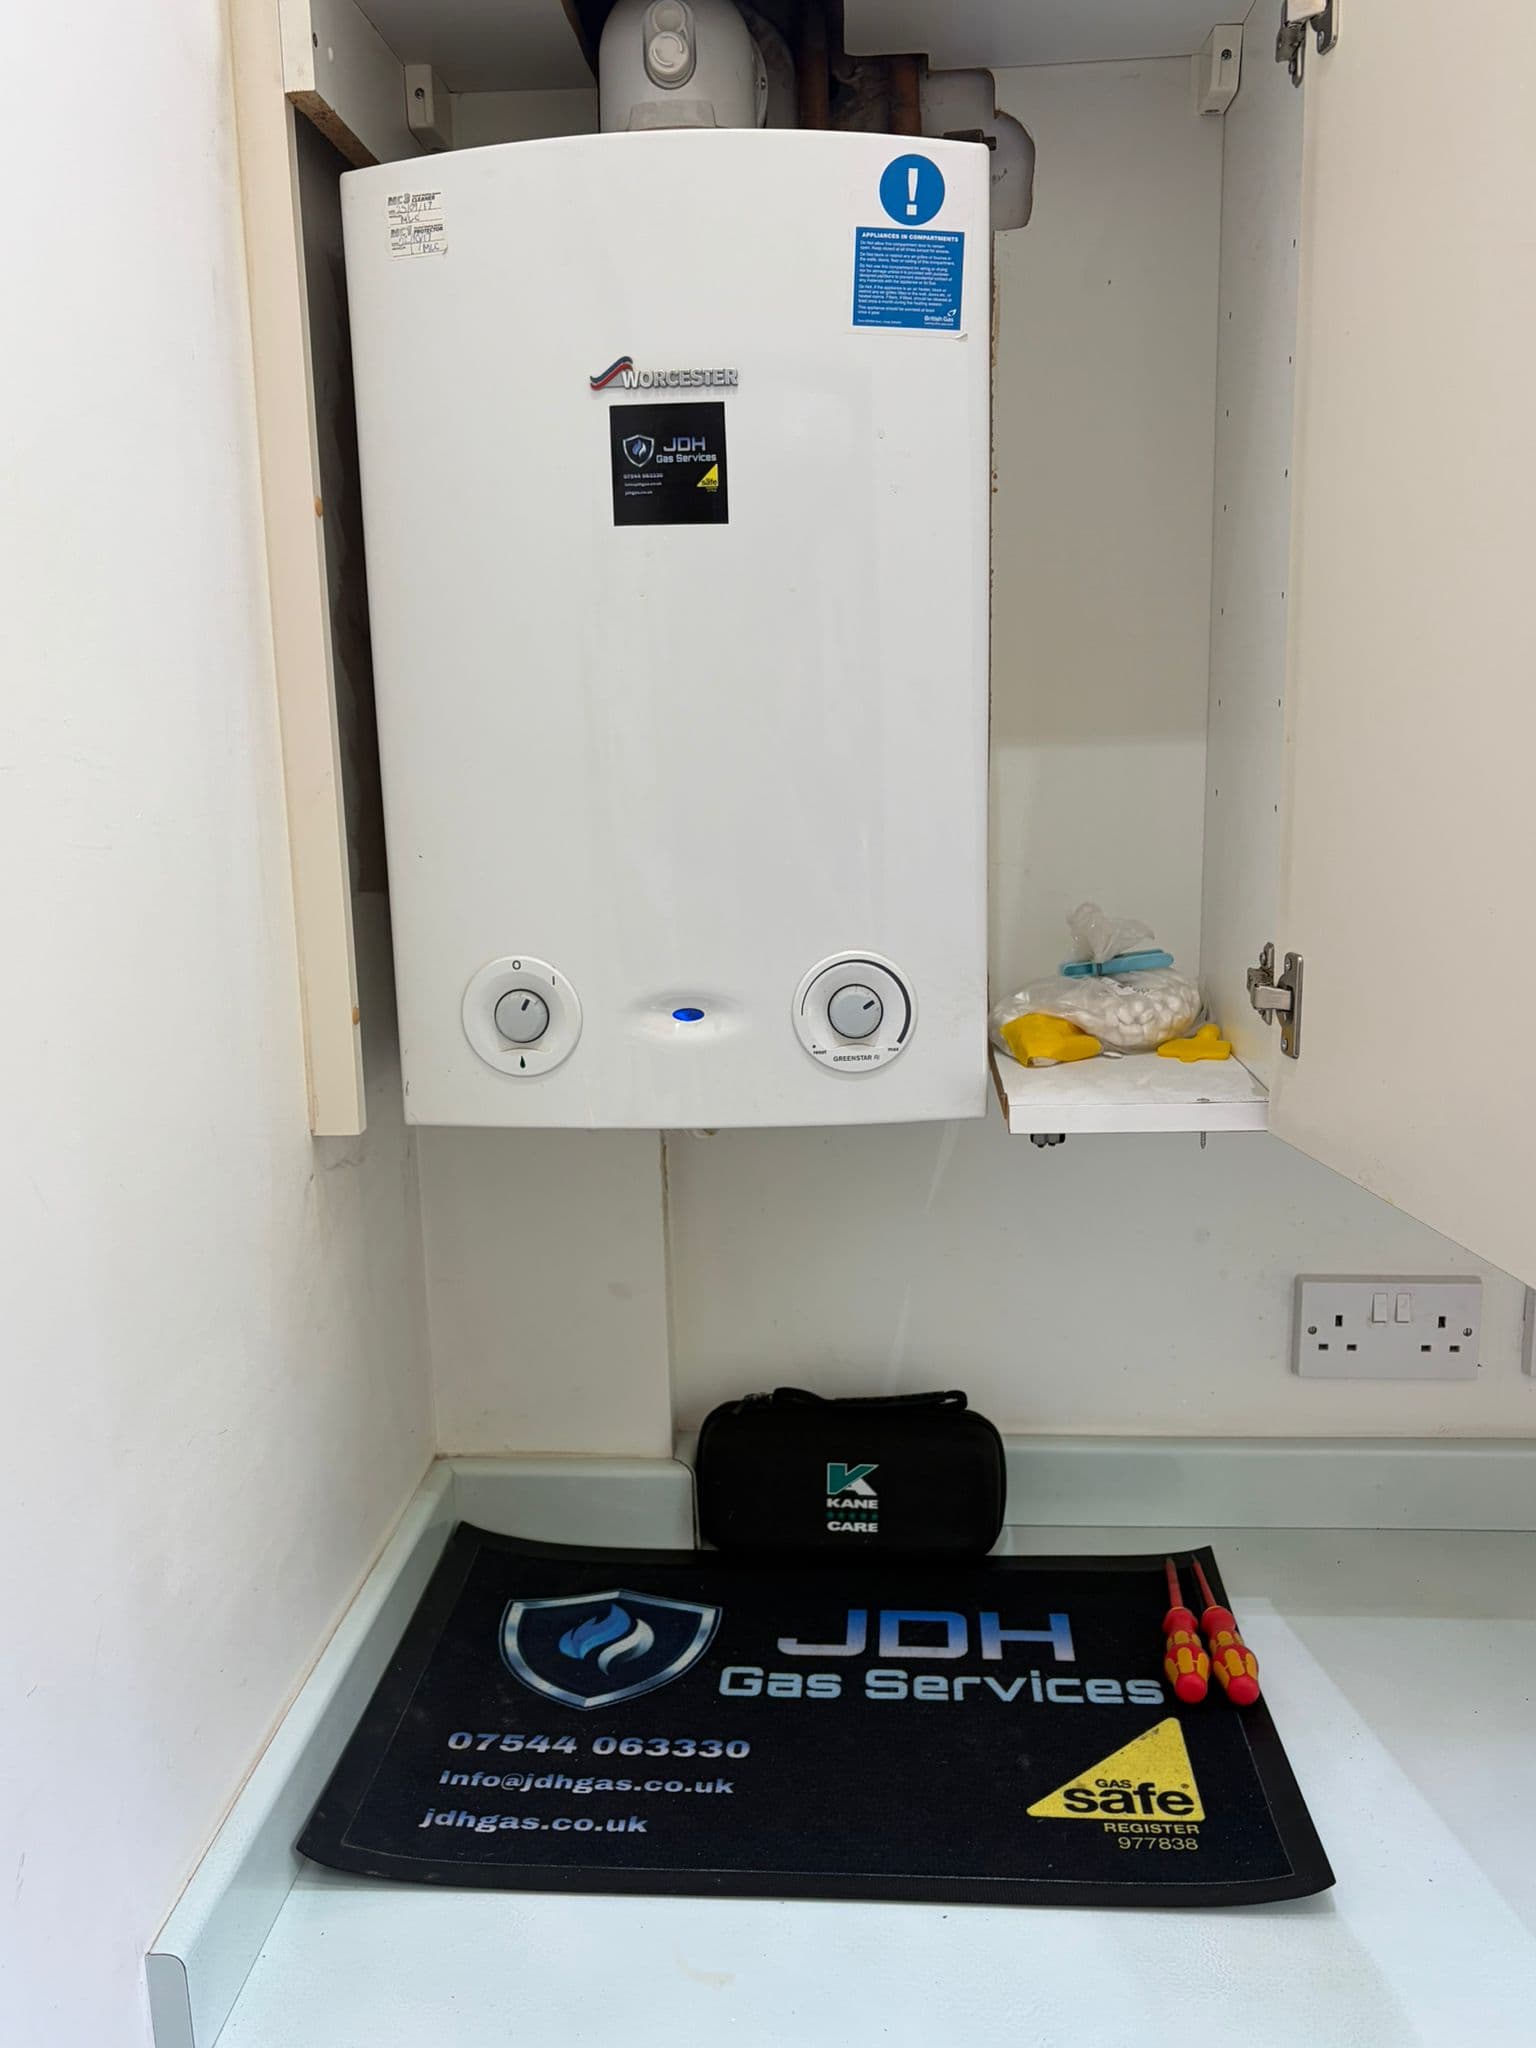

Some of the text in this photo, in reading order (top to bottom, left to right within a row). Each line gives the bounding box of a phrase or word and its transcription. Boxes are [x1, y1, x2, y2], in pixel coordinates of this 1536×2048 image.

[909, 234, 959, 242] COMPARTMENTS
[924, 314, 955, 323] British Gas
[622, 367, 738, 389] WORCESTER
[663, 436, 706, 452] JDH
[656, 453, 718, 464] Gas Services
[833, 1054, 872, 1062] GREENSTAR
[826, 1498, 880, 1510] KANE
[826, 1521, 880, 1533] CARE
[777, 1609, 1076, 1662] JDH
[718, 1666, 1165, 1705] Gas Services
[447, 1732, 751, 1759] 07544 063330
[1095, 1778, 1132, 1789] GAS
[1063, 1783, 1195, 1816] safe
[419, 1807, 648, 1833] jdhgas.co.uk
[1103, 1822, 1200, 1835] REGISTER
[1118, 1836, 1199, 1851] 977838
